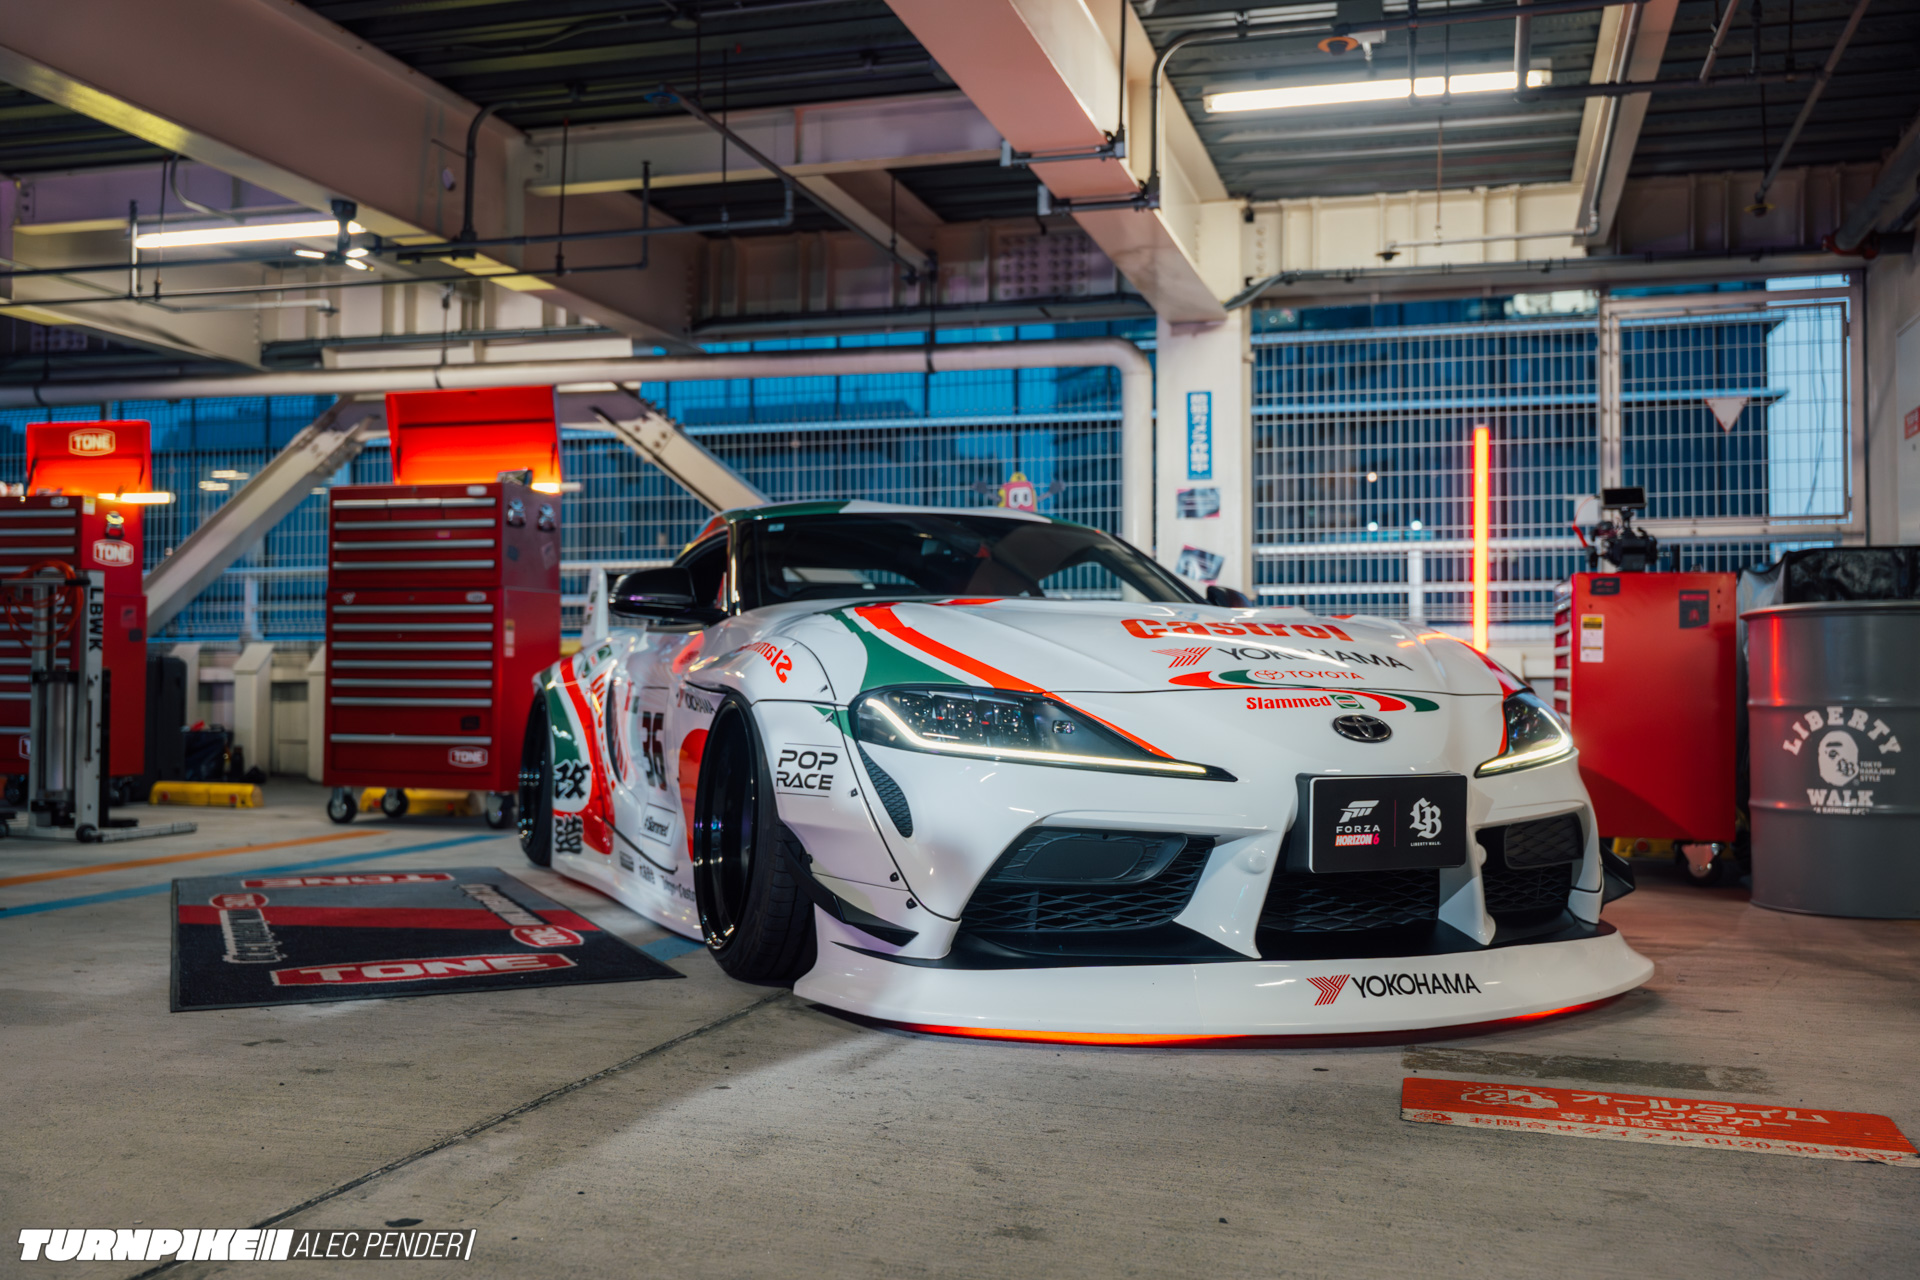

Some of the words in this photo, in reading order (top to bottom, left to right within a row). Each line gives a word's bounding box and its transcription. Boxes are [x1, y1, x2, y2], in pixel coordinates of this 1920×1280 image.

[74, 434, 110, 450] TONE
[96, 543, 132, 561] TONE
[89, 586, 103, 652] LBWK
[1120, 618, 1354, 642] Castrol
[1284, 670, 1365, 680] TOYOTA
[1246, 695, 1331, 710] Slammed
[1783, 706, 1901, 755] LIBERTY
[453, 750, 483, 764] TONE
[778, 749, 838, 770] POP
[776, 771, 834, 791] RACE
[1807, 788, 1873, 807] WALK
[1335, 834, 1372, 845] HORIZON
[1373, 833, 1380, 845] 6
[1336, 825, 1380, 833] FORZA
[300, 955, 549, 981] TONE
[1351, 973, 1482, 998] YOKOHAMA
[1571, 1093, 1830, 1124] オールタイム
[1617, 1107, 1791, 1127] レンタカー
